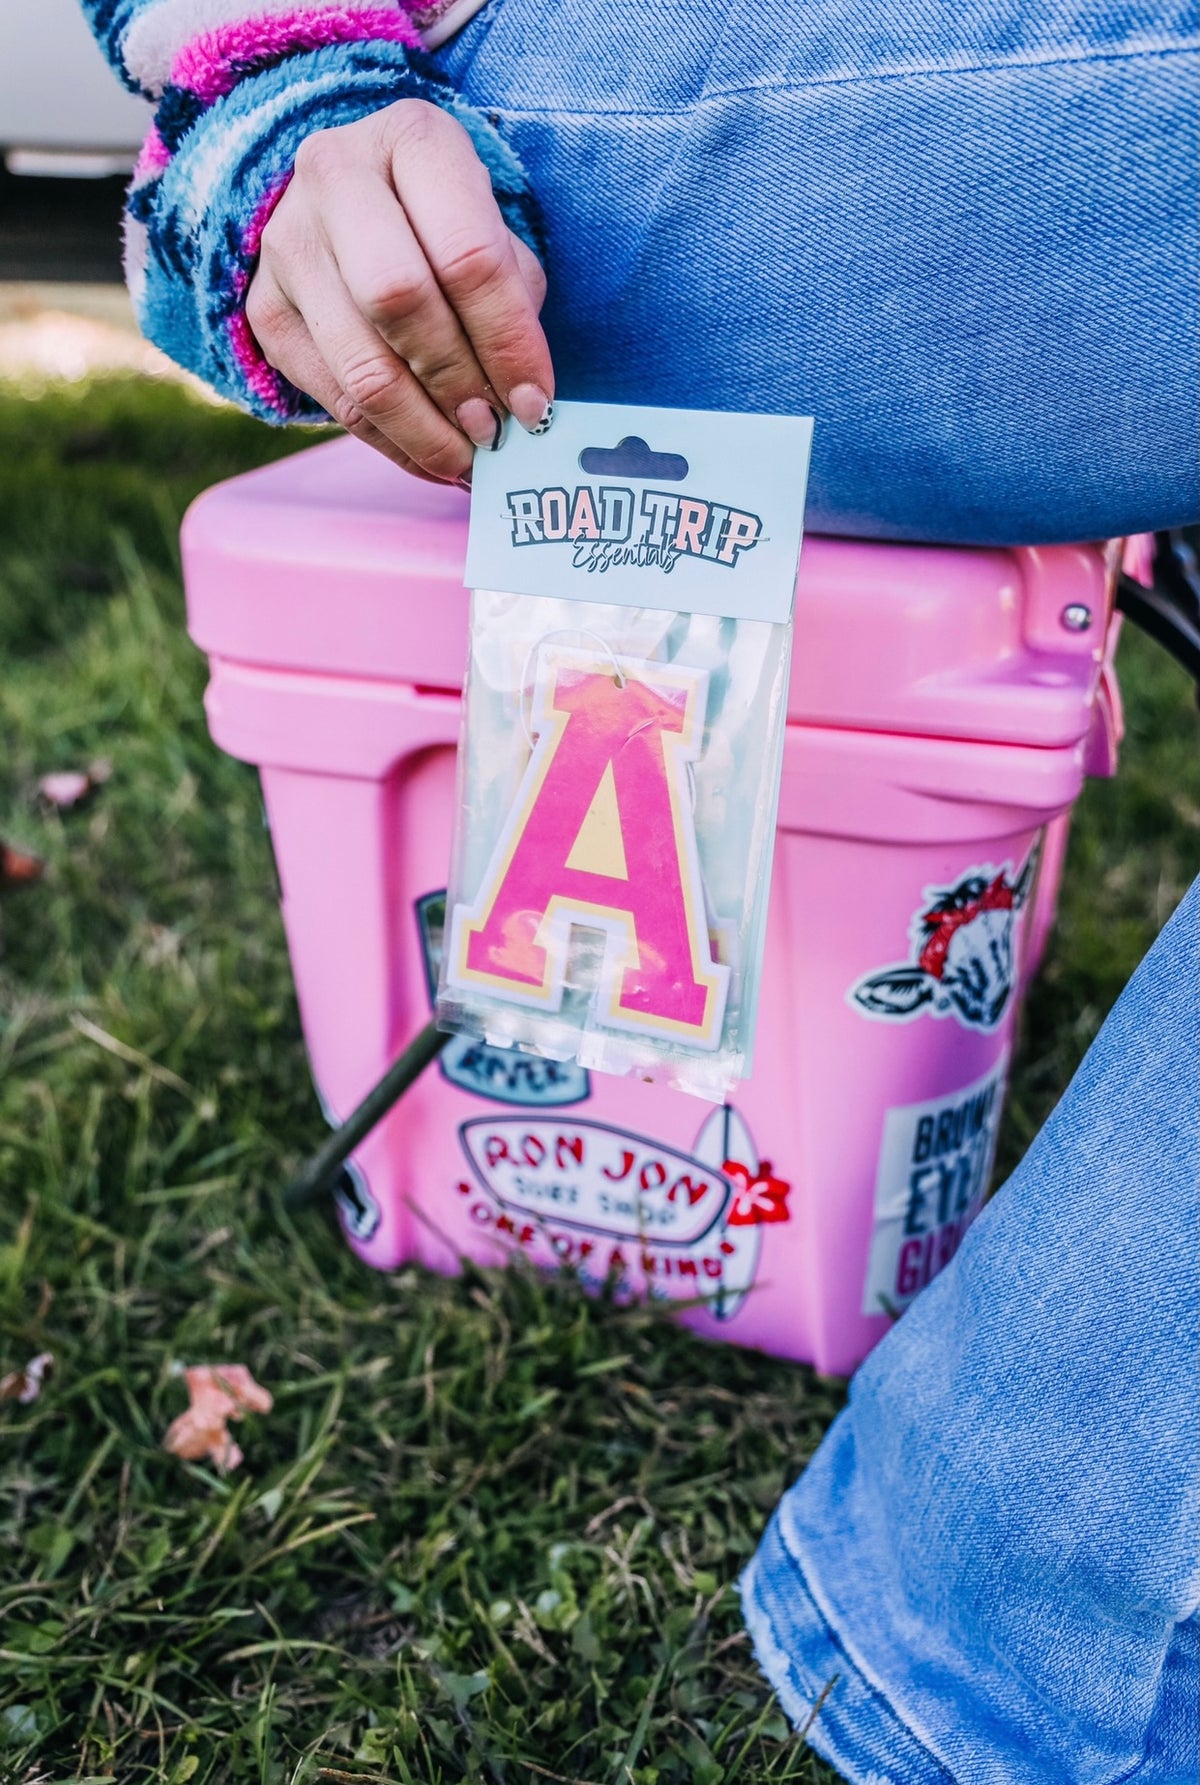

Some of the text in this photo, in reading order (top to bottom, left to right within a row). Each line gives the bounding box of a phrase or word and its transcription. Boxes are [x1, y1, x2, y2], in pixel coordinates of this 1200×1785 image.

[506, 486, 764, 568] ROAD TRIP
[571, 528, 683, 574] Essentials
[462, 662, 713, 1035] A
[484, 1134, 709, 1207] RON JON
[469, 1201, 535, 1243] ONE
